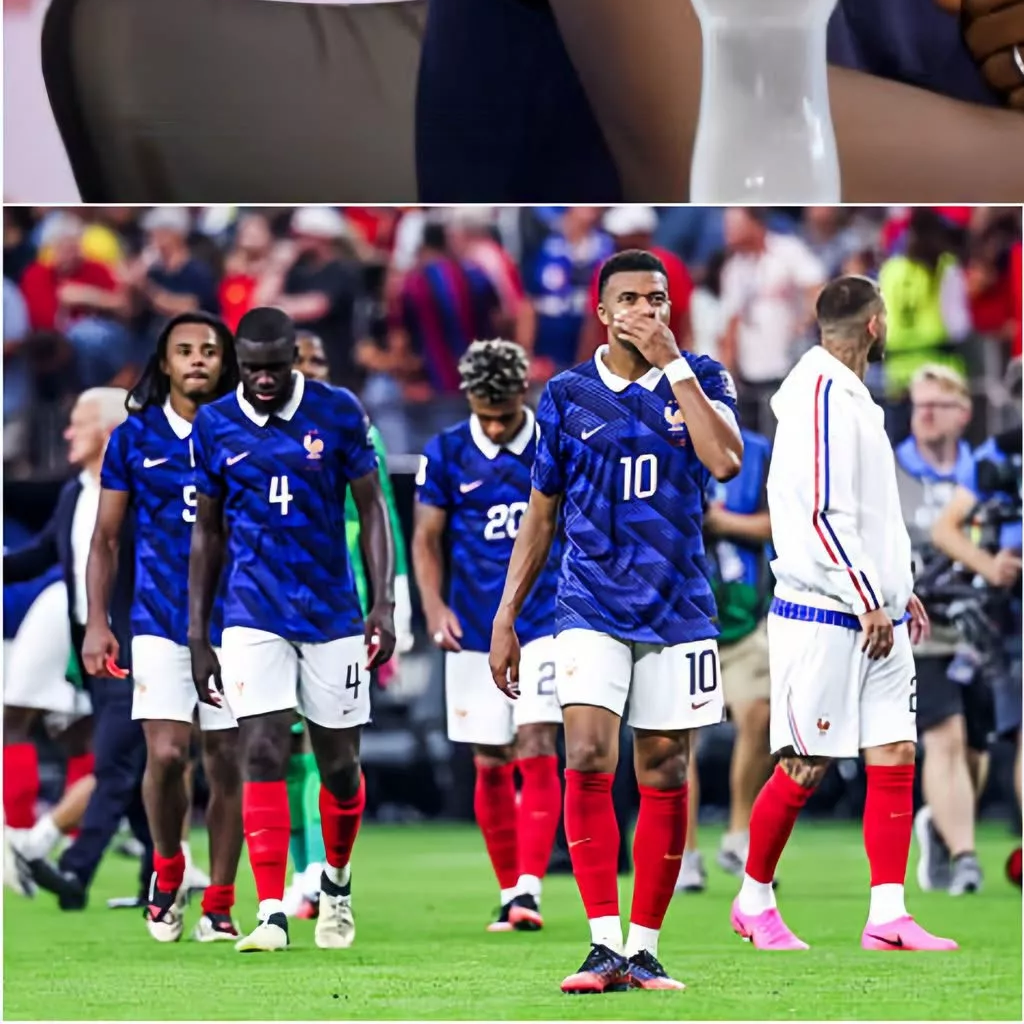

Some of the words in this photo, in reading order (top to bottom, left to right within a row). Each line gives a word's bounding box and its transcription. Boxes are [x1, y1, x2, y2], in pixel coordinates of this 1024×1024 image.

[269, 475, 293, 516] 4
[620, 453, 658, 501] 10
[484, 501, 530, 541] 20
[345, 661, 361, 700] 4
[685, 648, 717, 696] 10
